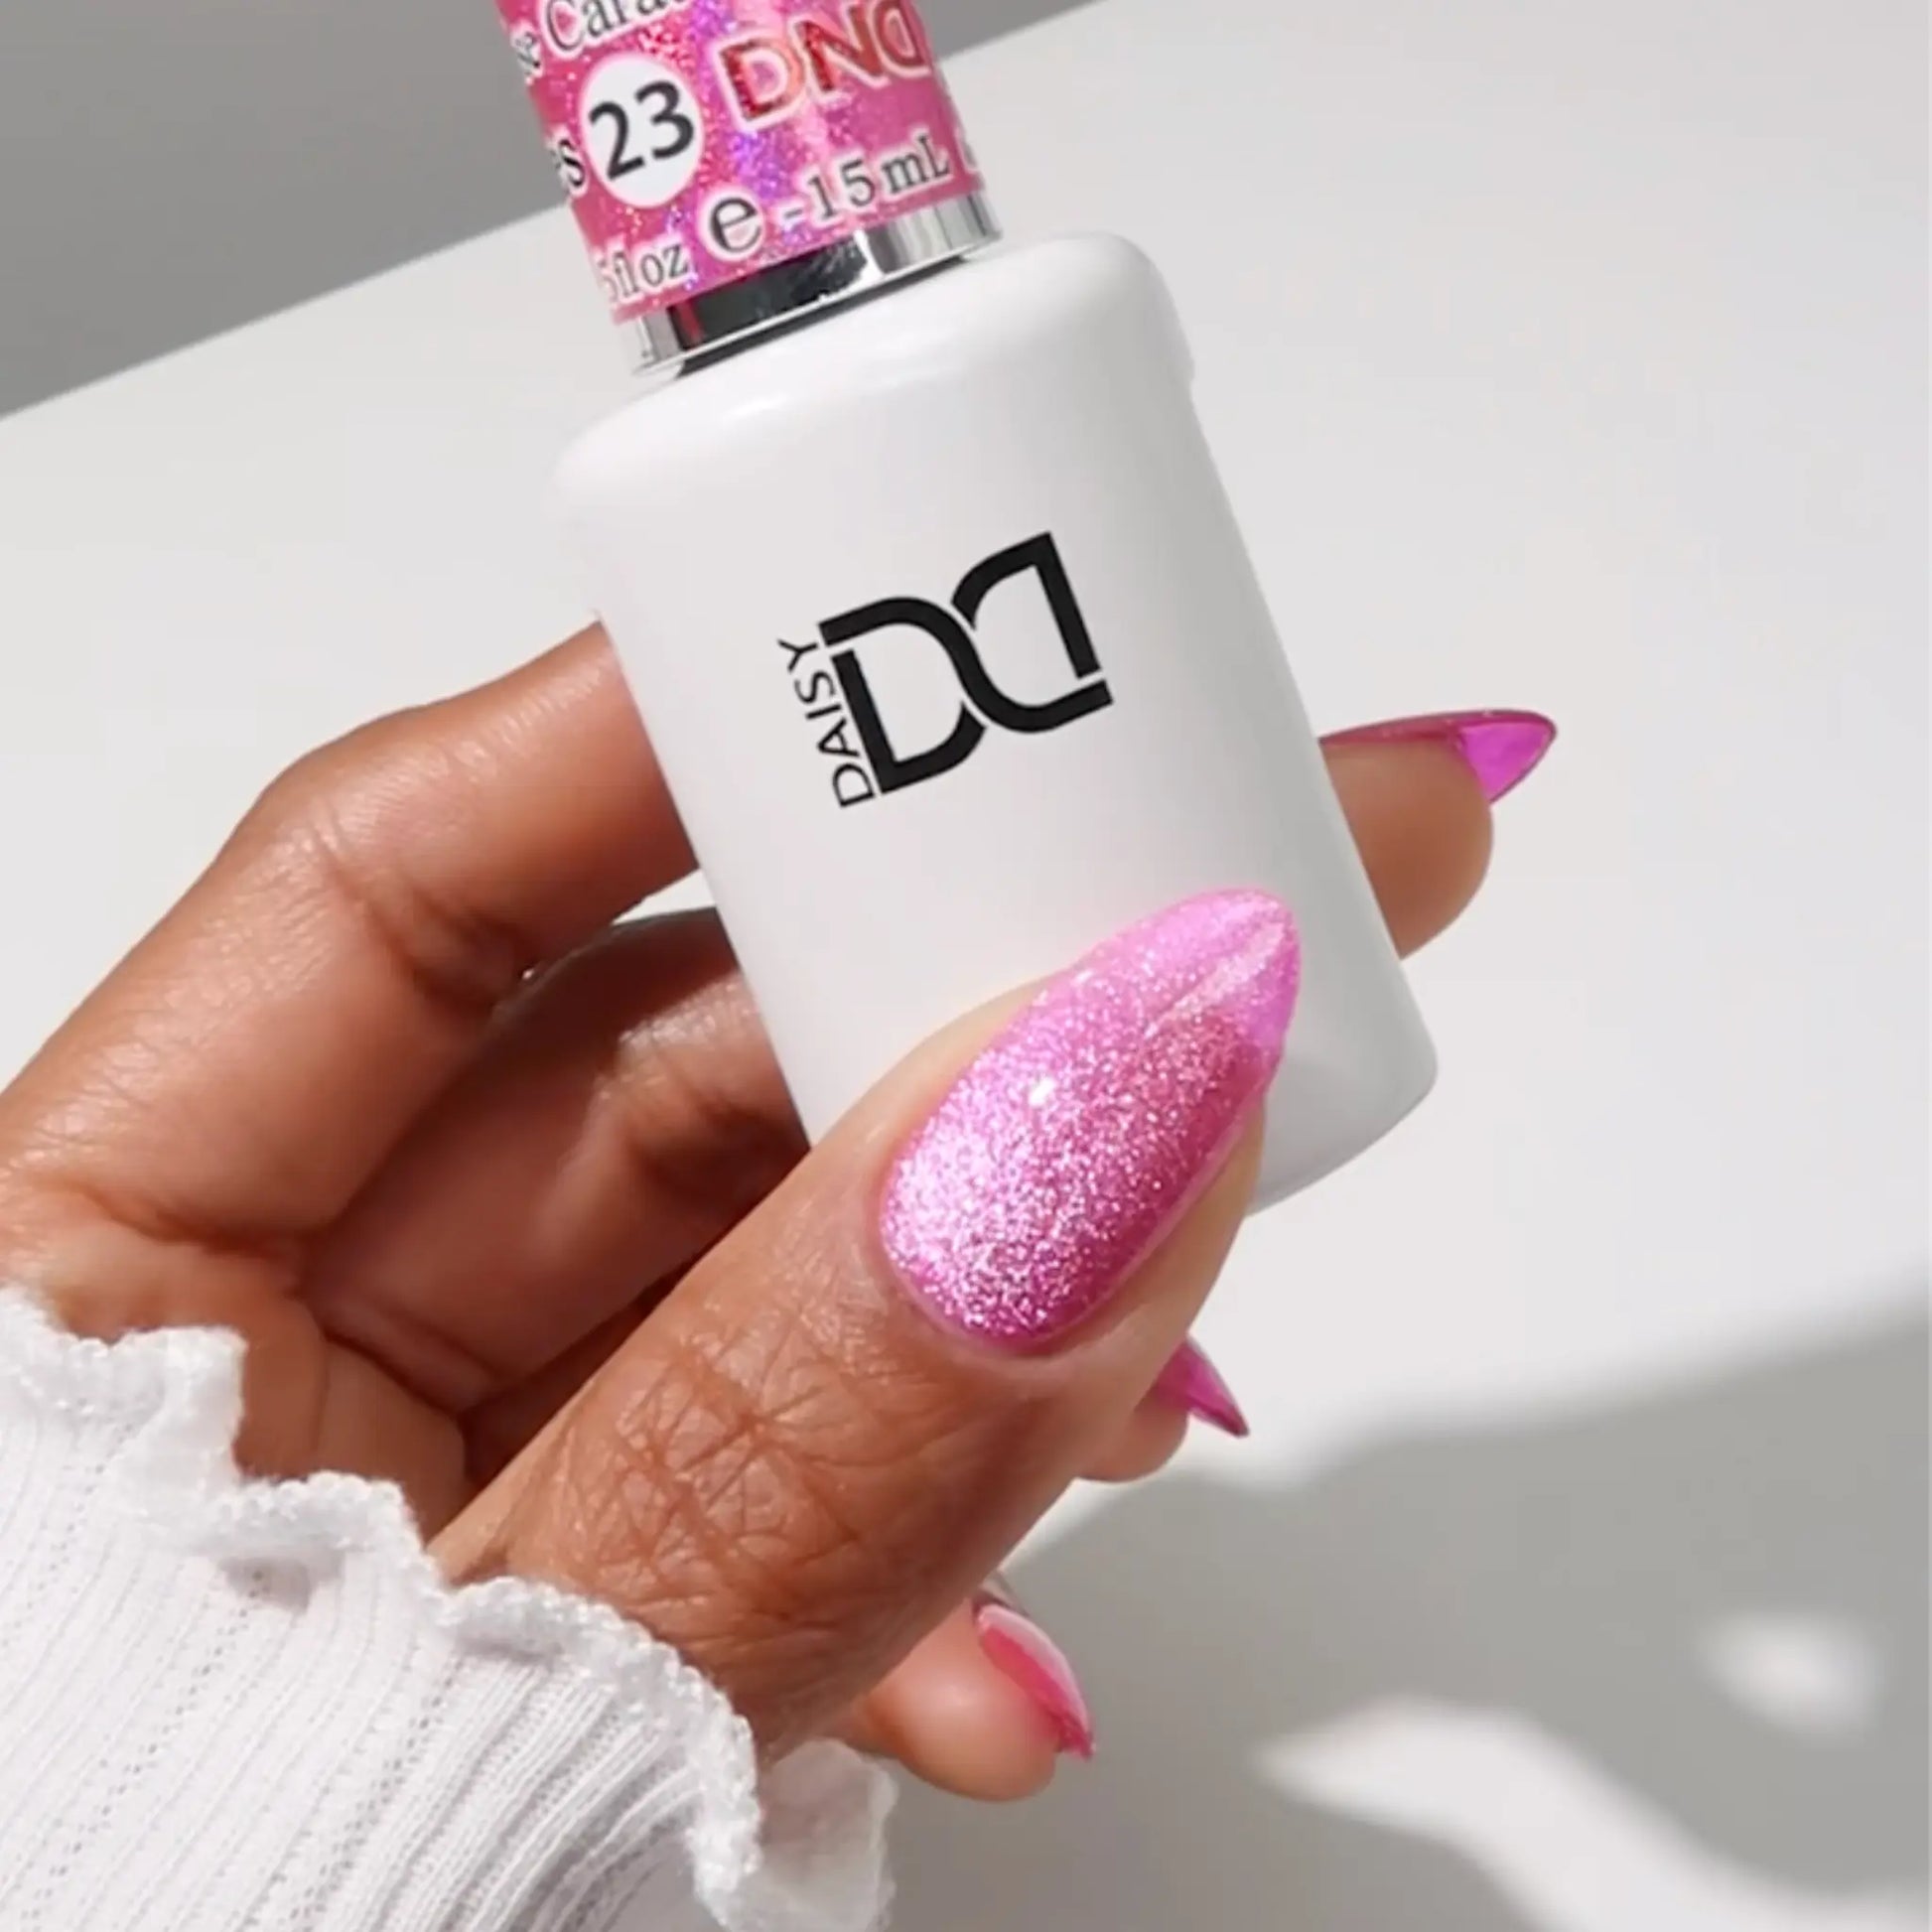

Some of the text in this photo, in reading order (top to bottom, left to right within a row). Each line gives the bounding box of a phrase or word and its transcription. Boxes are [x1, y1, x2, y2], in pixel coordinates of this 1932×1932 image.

[589, 79, 695, 180] 23
[710, 198, 761, 253] e
[776, 638, 875, 807] DAISY
